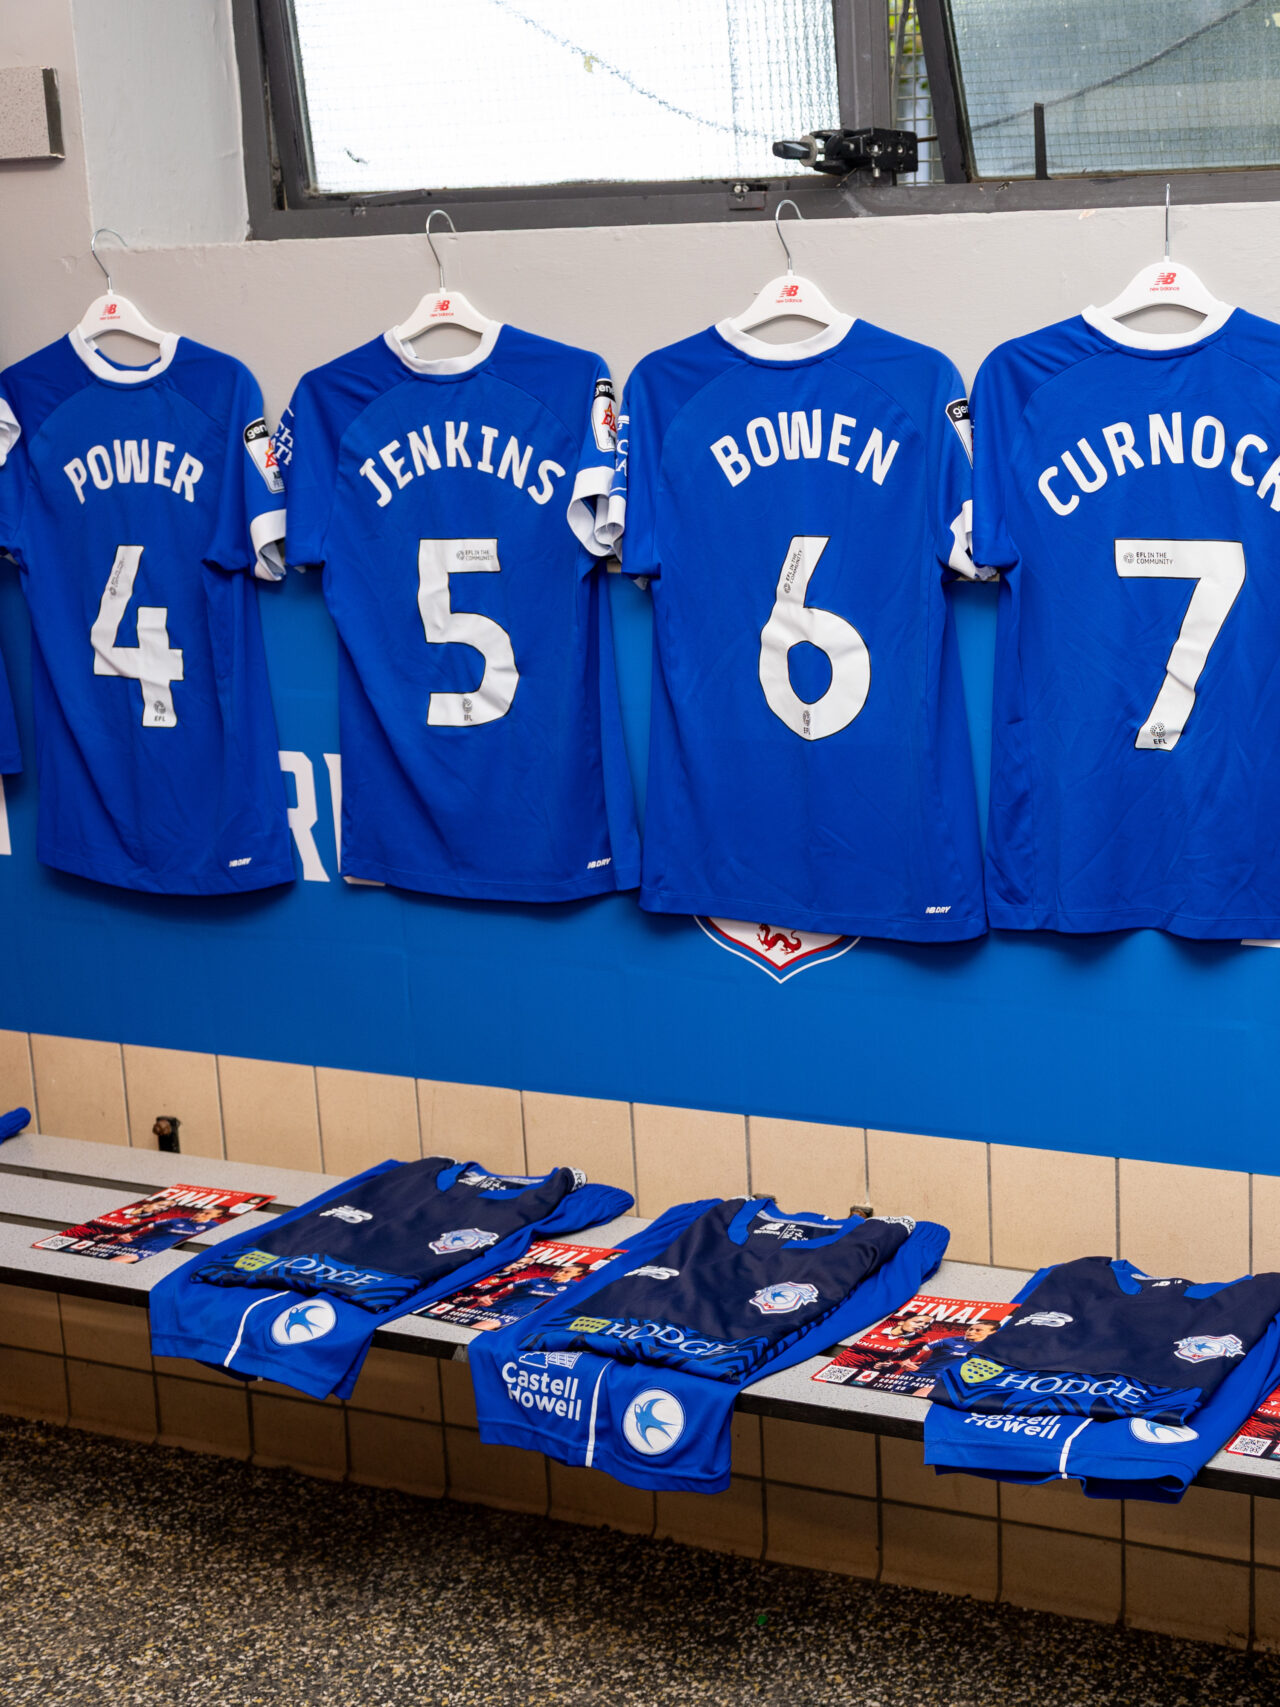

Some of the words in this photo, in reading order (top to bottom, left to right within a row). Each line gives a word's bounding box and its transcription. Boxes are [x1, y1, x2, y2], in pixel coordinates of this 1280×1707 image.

[63, 438, 204, 504] POWER
[359, 421, 565, 507] JENKINS
[709, 408, 900, 488] BOWEN
[90, 544, 185, 728] 4
[417, 538, 520, 727] 5
[758, 535, 872, 741] 6
[1114, 538, 1247, 752] 7
[146, 1188, 231, 1209] FINAL
[525, 1245, 590, 1267] INAL
[893, 1300, 991, 1325] FINAL
[501, 1361, 579, 1400] Castell
[507, 1383, 582, 1421] Howell
[996, 1373, 1148, 1404] HODGE
